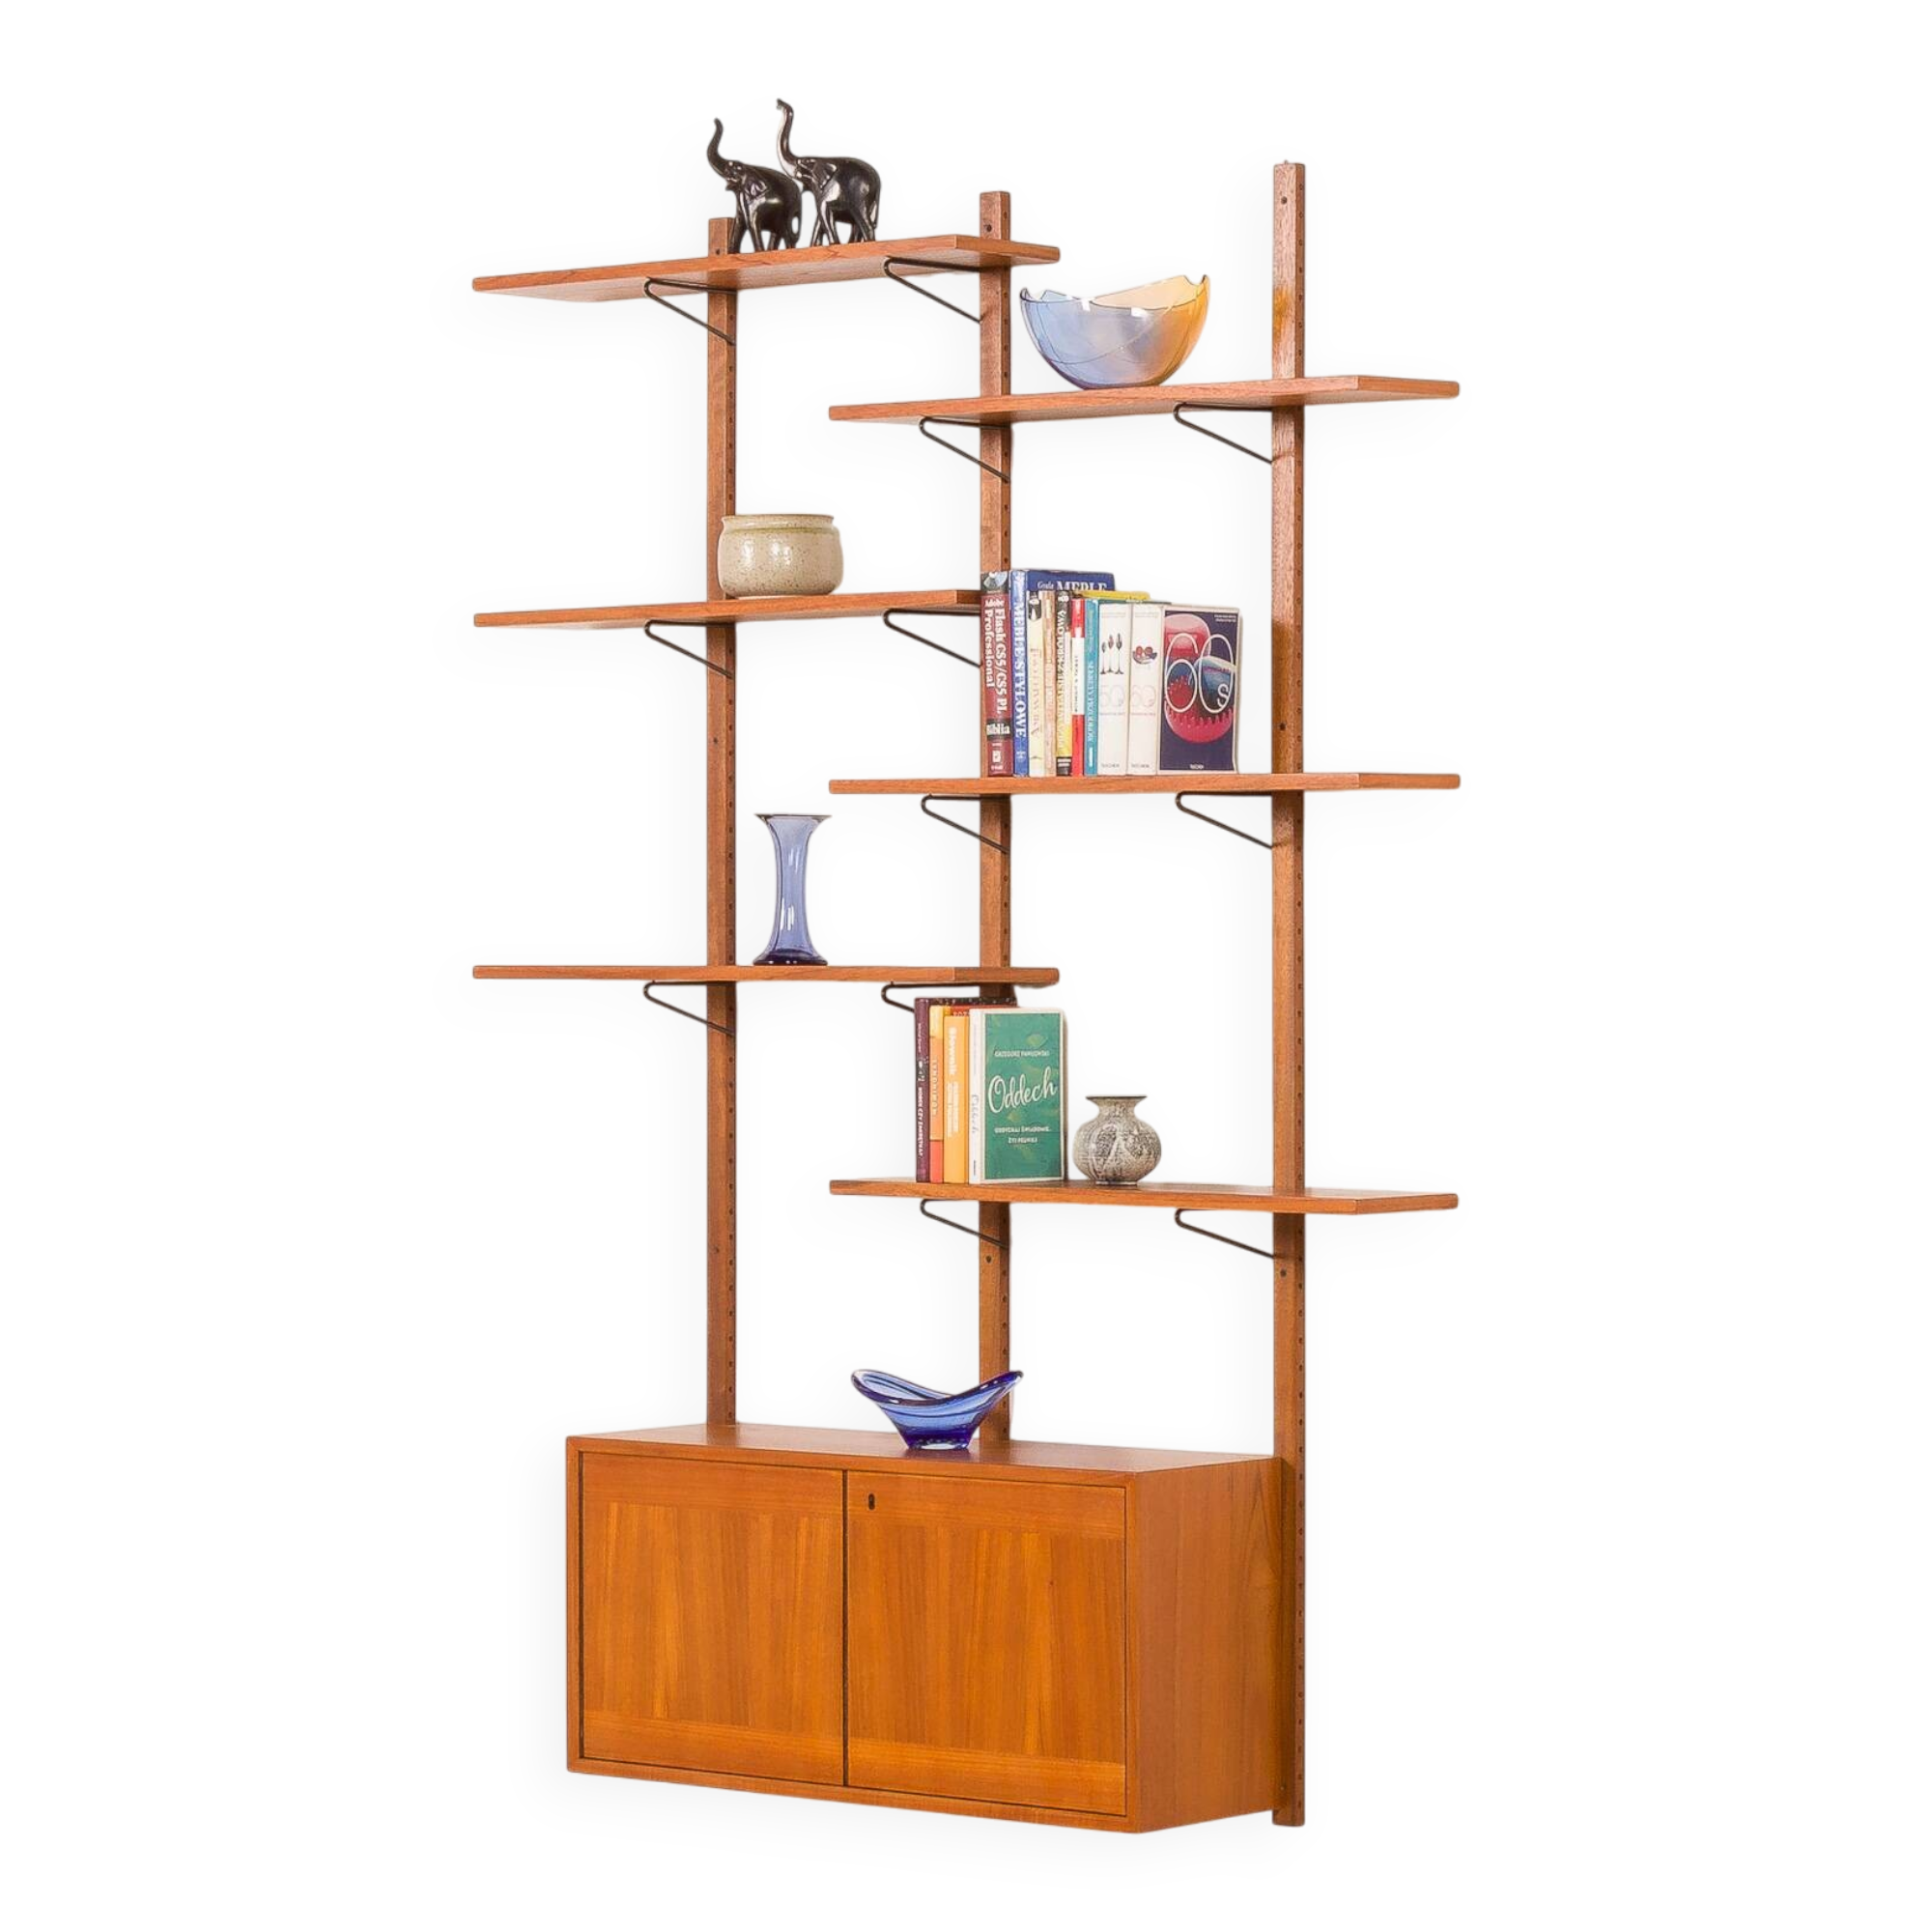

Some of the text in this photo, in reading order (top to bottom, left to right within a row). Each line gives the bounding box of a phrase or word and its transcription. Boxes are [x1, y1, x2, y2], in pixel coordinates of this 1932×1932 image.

[984, 610, 994, 687] Professional
[995, 609, 1007, 641] Flash
[1013, 603, 1027, 738] MEBLE STYLOWE
[987, 1065, 1058, 1113] Oddech
